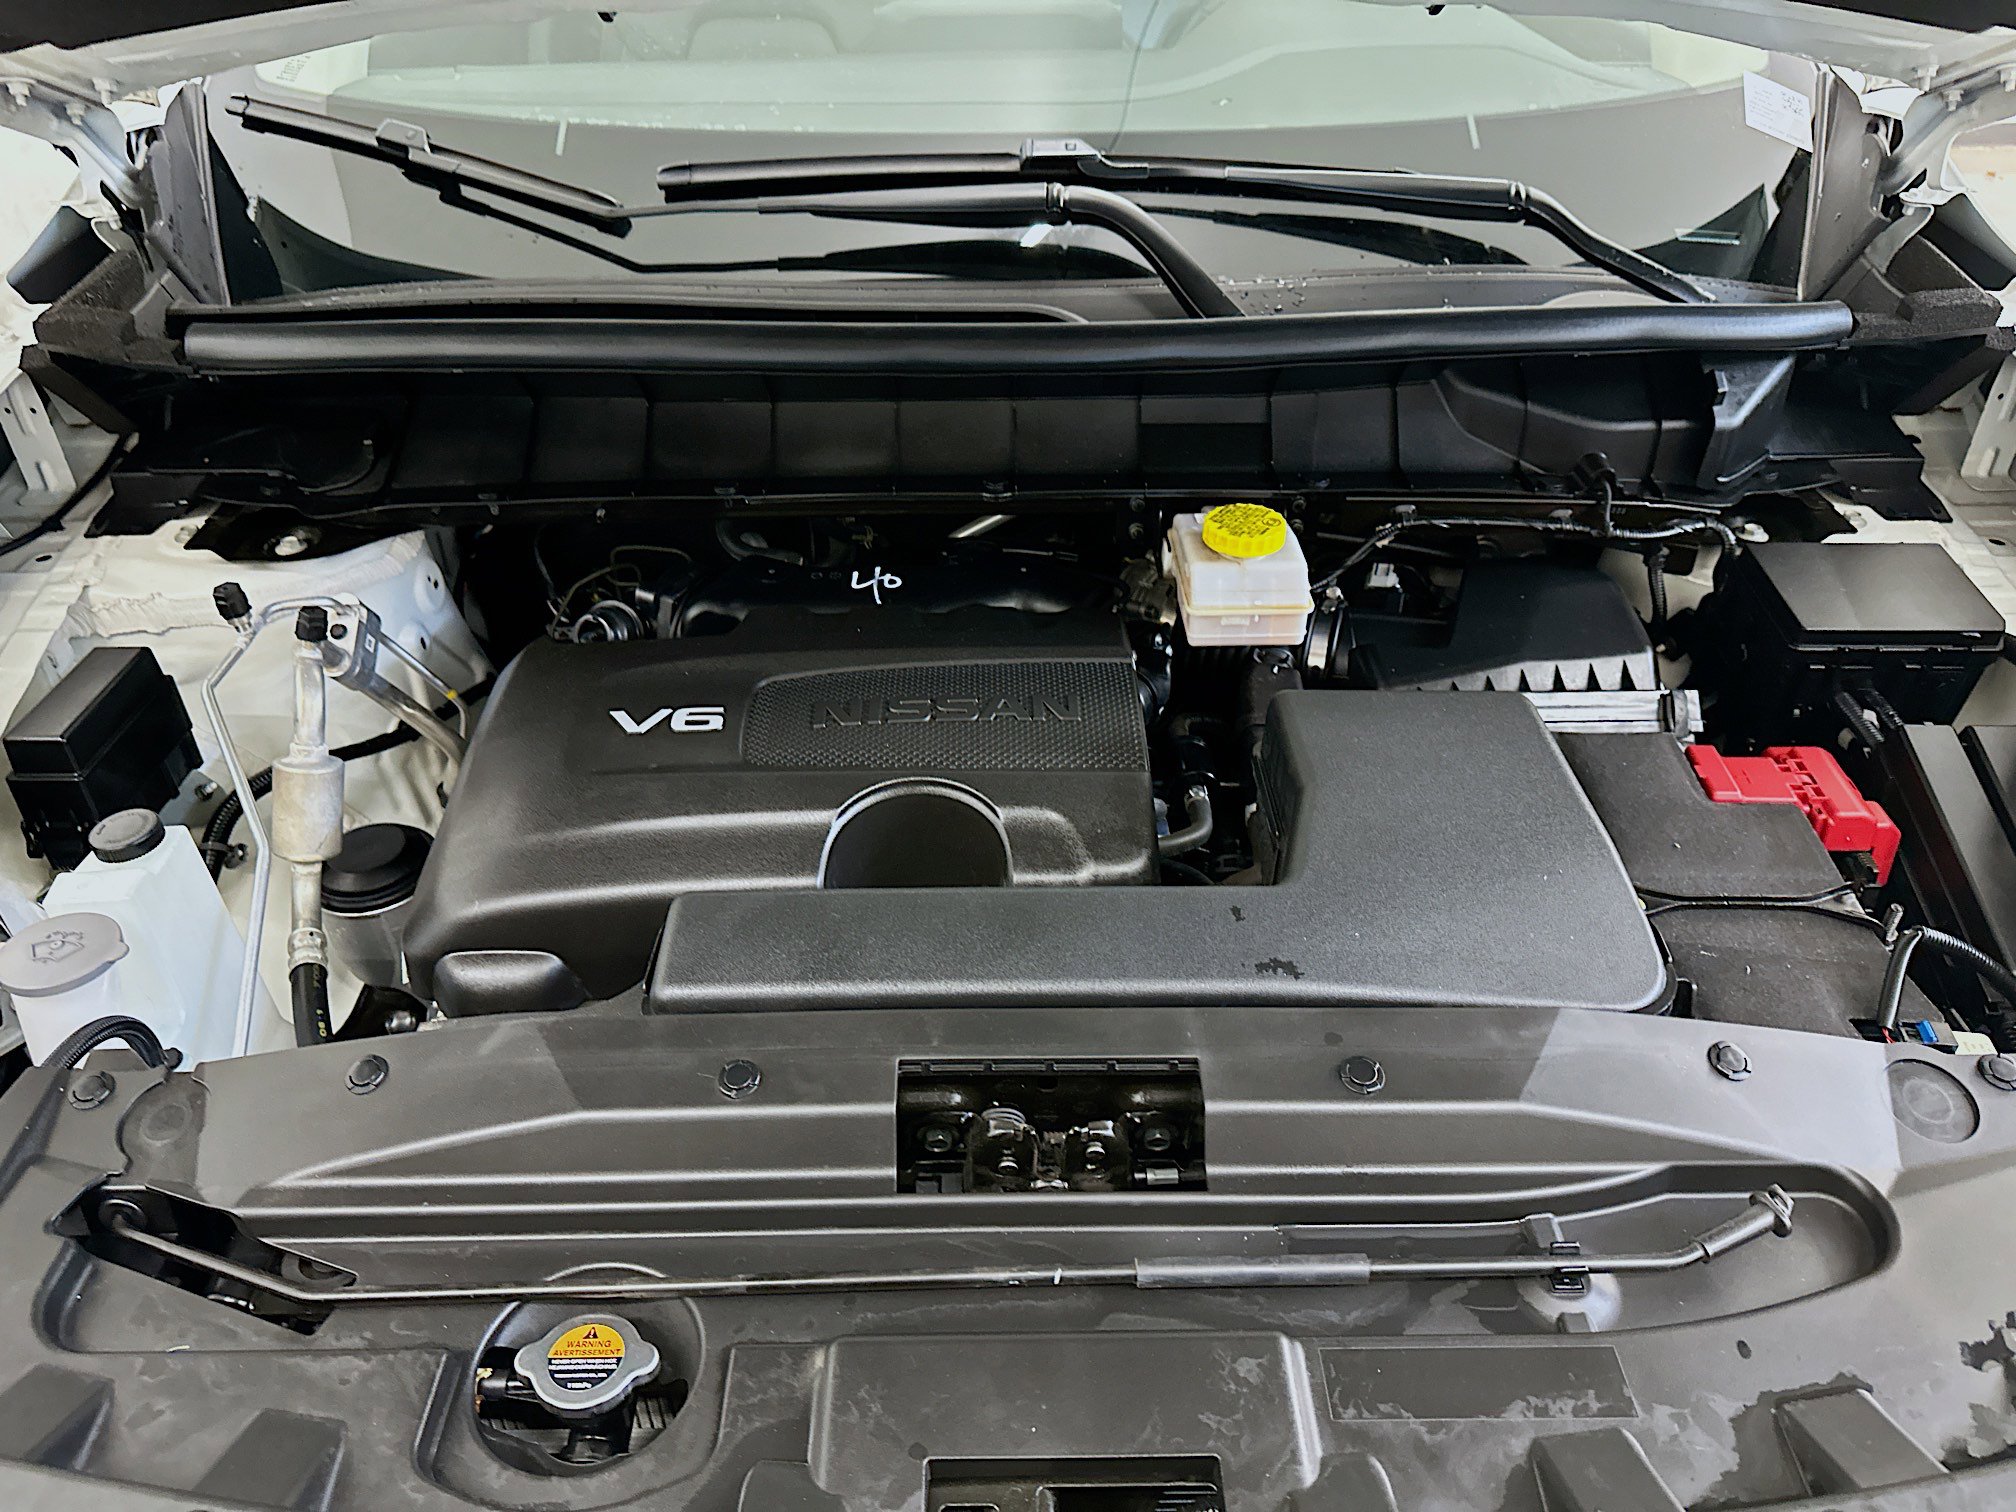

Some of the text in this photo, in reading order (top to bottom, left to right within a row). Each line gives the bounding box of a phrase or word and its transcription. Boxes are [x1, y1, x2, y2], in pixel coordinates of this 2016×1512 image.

[851, 566, 902, 605] 40
[608, 706, 725, 734] V6
[813, 694, 1082, 729] NISSAN
[567, 1340, 611, 1348] WARNING
